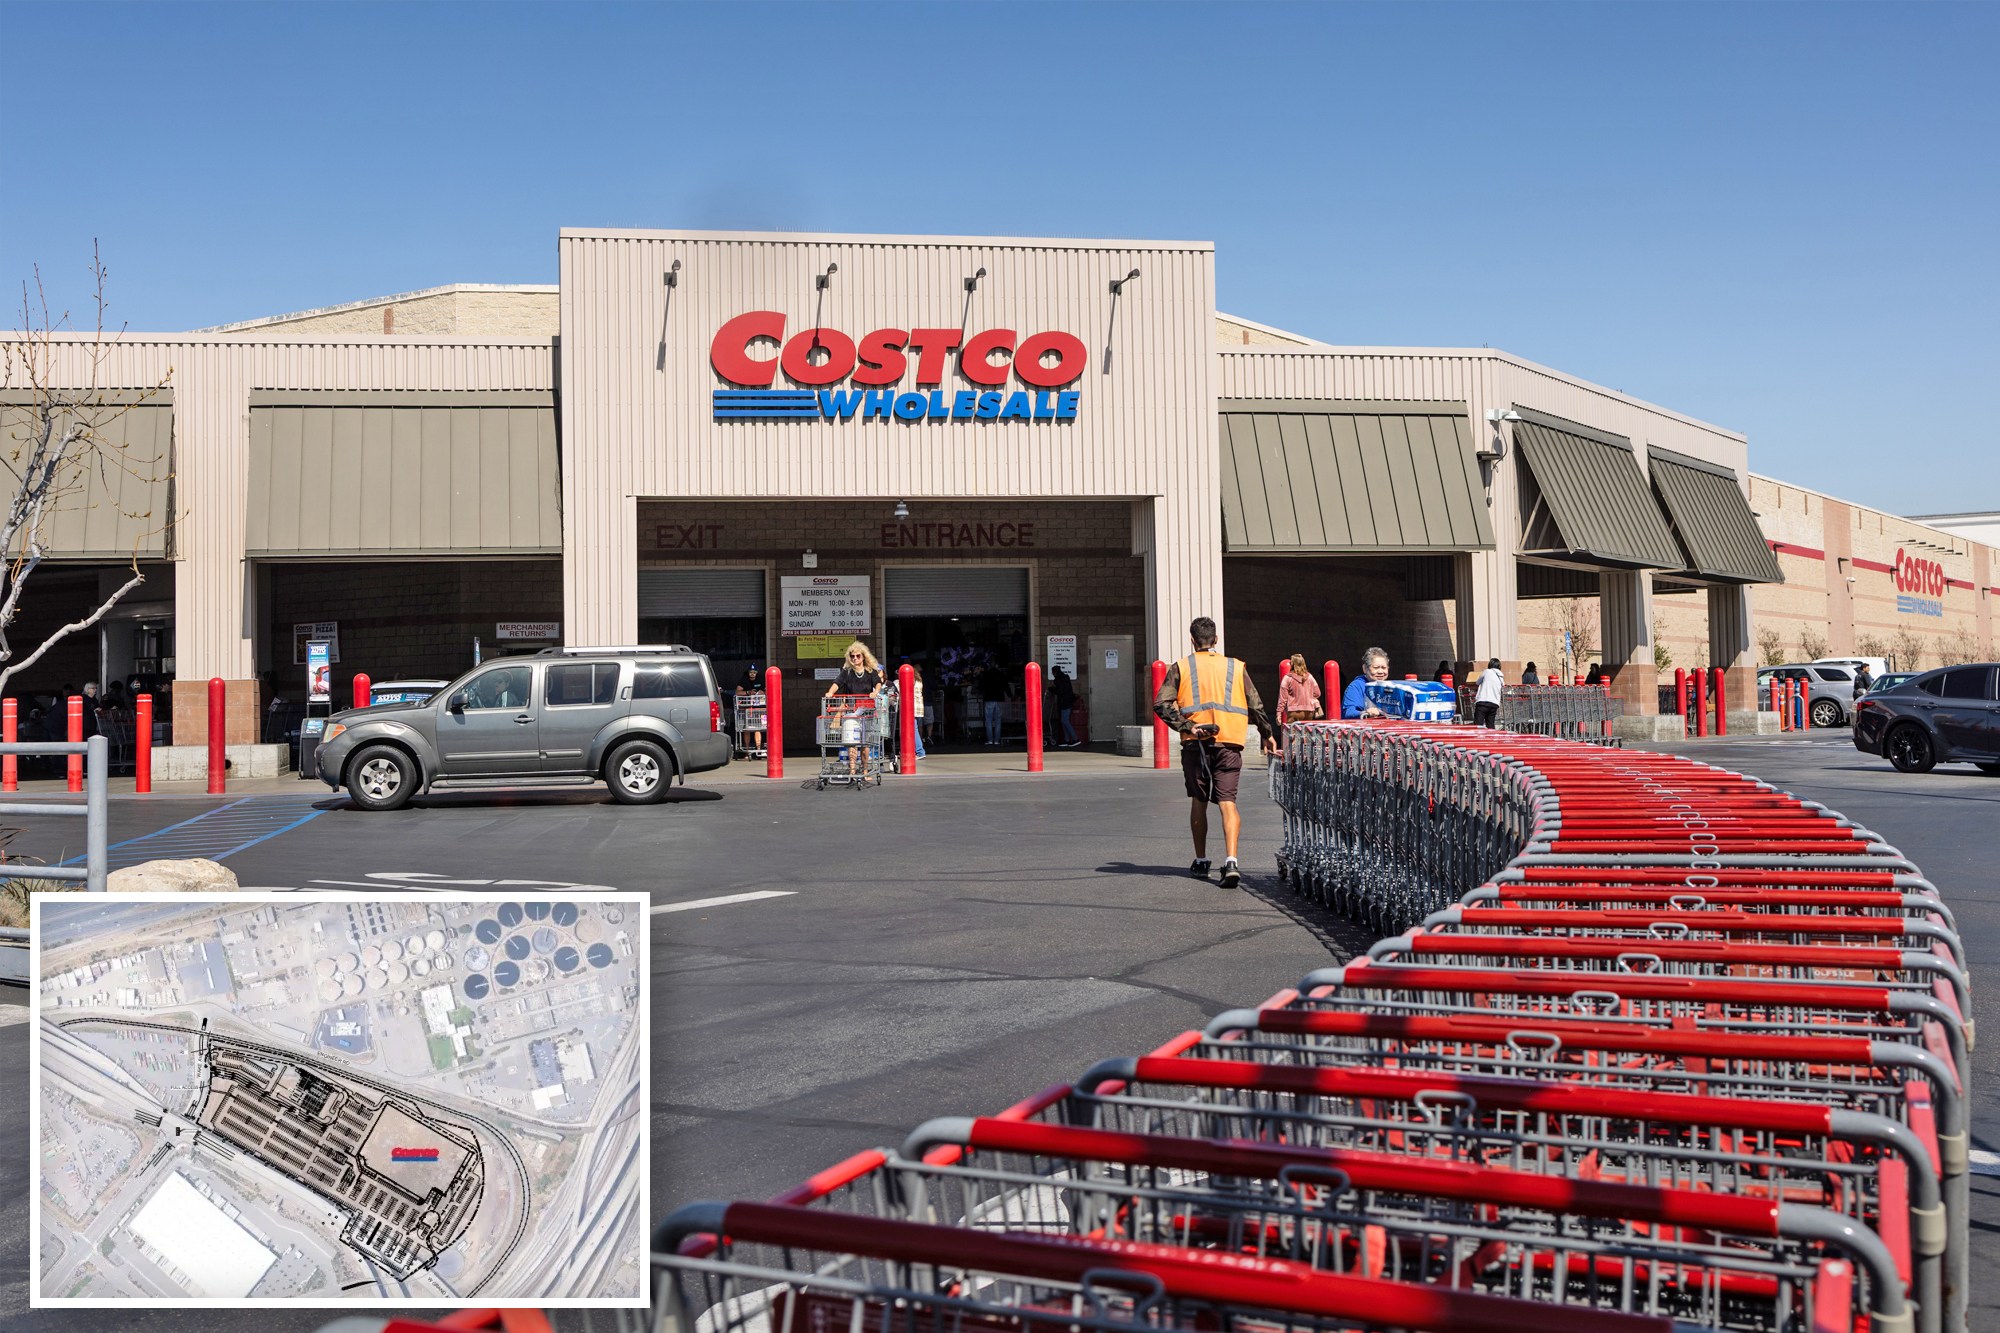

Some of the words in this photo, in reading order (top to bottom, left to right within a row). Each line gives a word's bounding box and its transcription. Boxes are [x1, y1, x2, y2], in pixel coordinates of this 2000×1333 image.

[711, 310, 1087, 387] COSTCO
[819, 390, 1080, 420] WHOLESALE
[656, 524, 725, 549] EXIT
[881, 523, 1035, 548] ENTRANCE
[1896, 548, 1943, 597] COSTCO
[789, 610, 822, 618] SATURDAY
